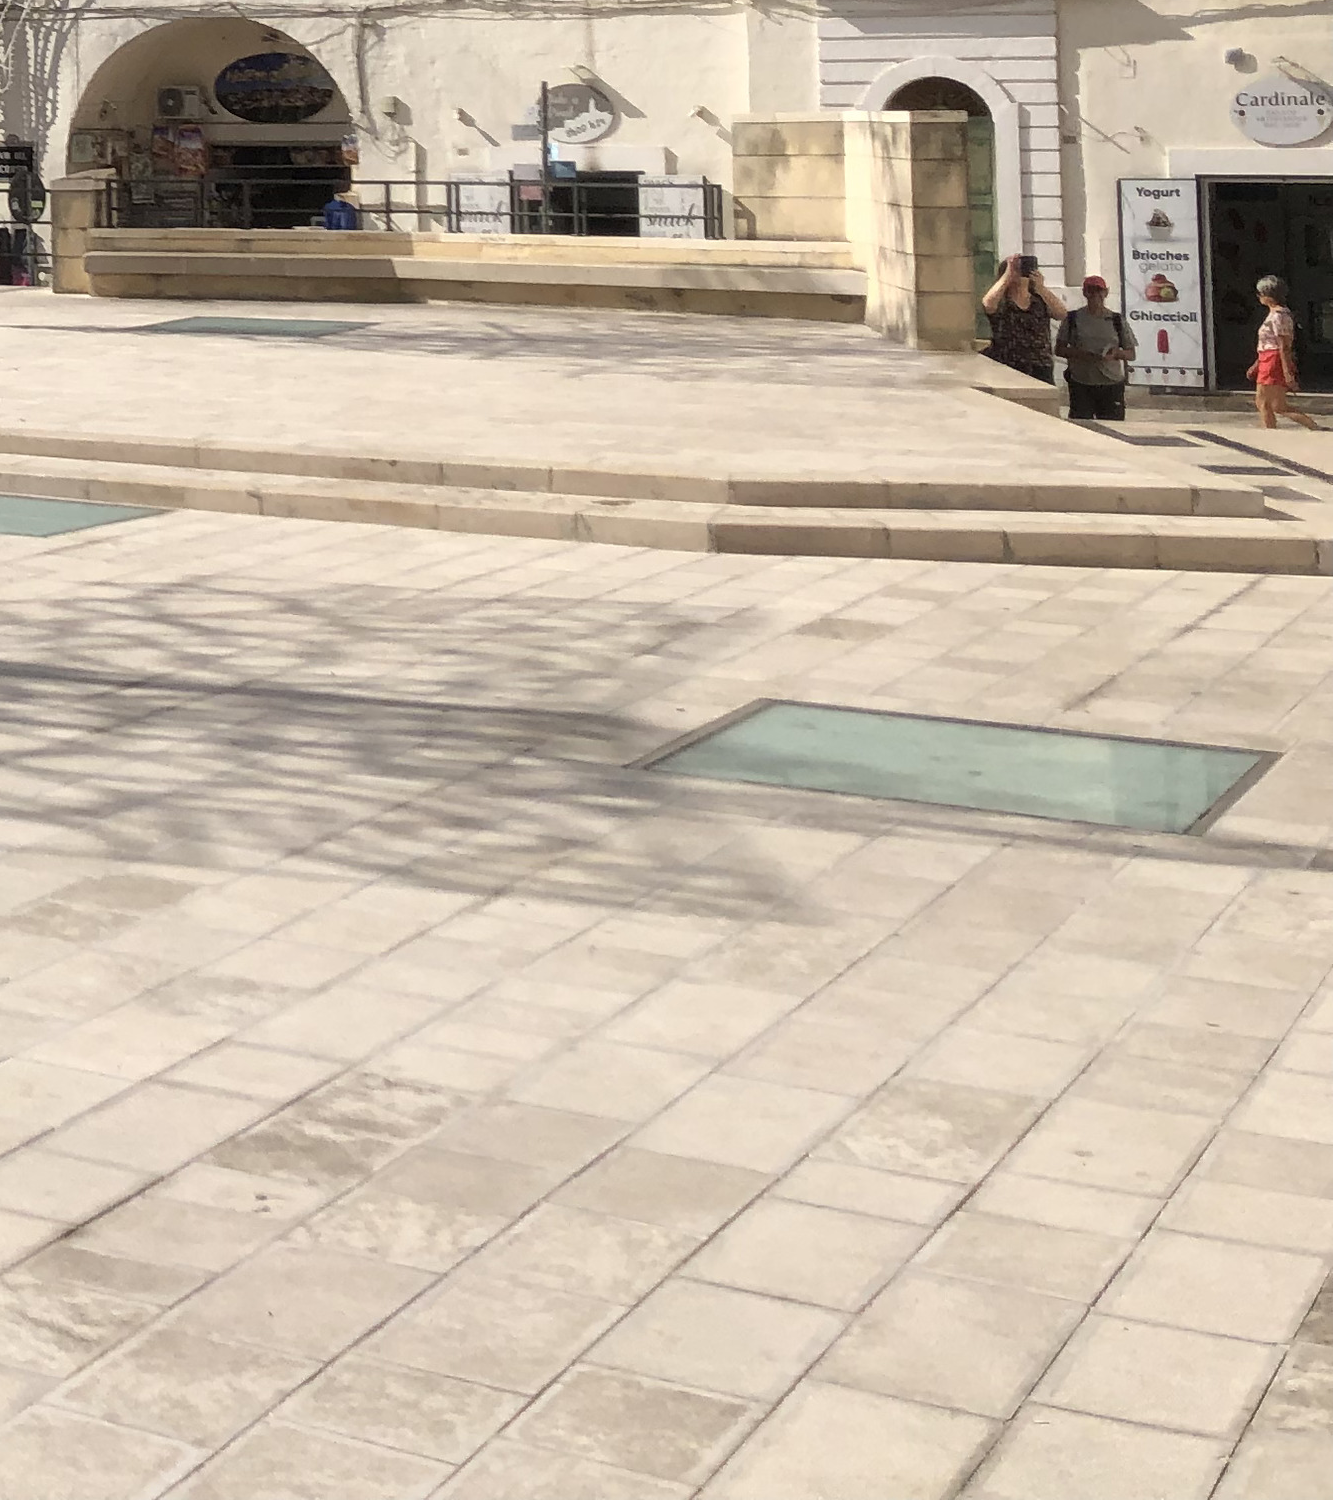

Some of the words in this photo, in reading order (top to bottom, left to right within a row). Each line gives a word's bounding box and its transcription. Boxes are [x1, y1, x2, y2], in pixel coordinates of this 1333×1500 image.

[1236, 91, 1326, 106] Cardinale
[1136, 187, 1181, 200] Yogurt
[1132, 250, 1190, 261] Brioches
[1138, 261, 1184, 274] gelato
